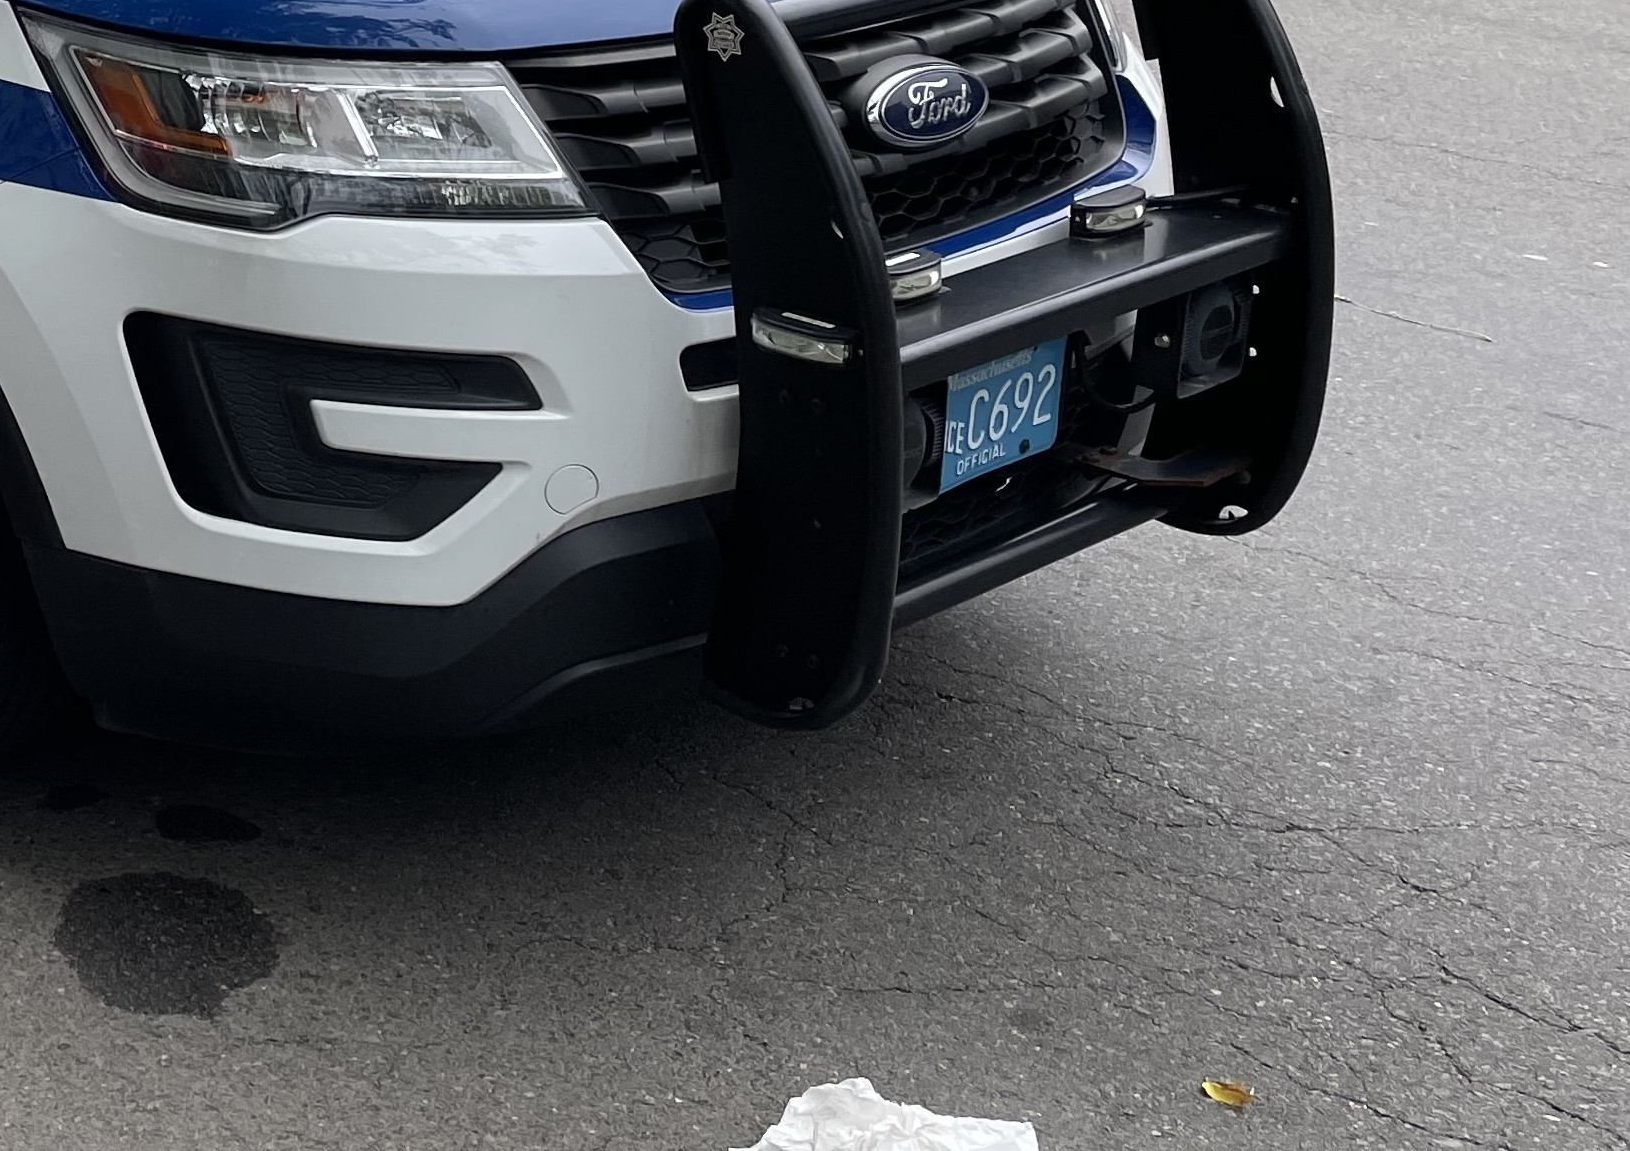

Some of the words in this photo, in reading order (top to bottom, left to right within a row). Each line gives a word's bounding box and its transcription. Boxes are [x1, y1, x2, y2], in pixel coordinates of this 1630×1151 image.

[907, 77, 972, 130] Ford
[967, 363, 1057, 451] C692
[956, 443, 1007, 476] OFFICIAL
